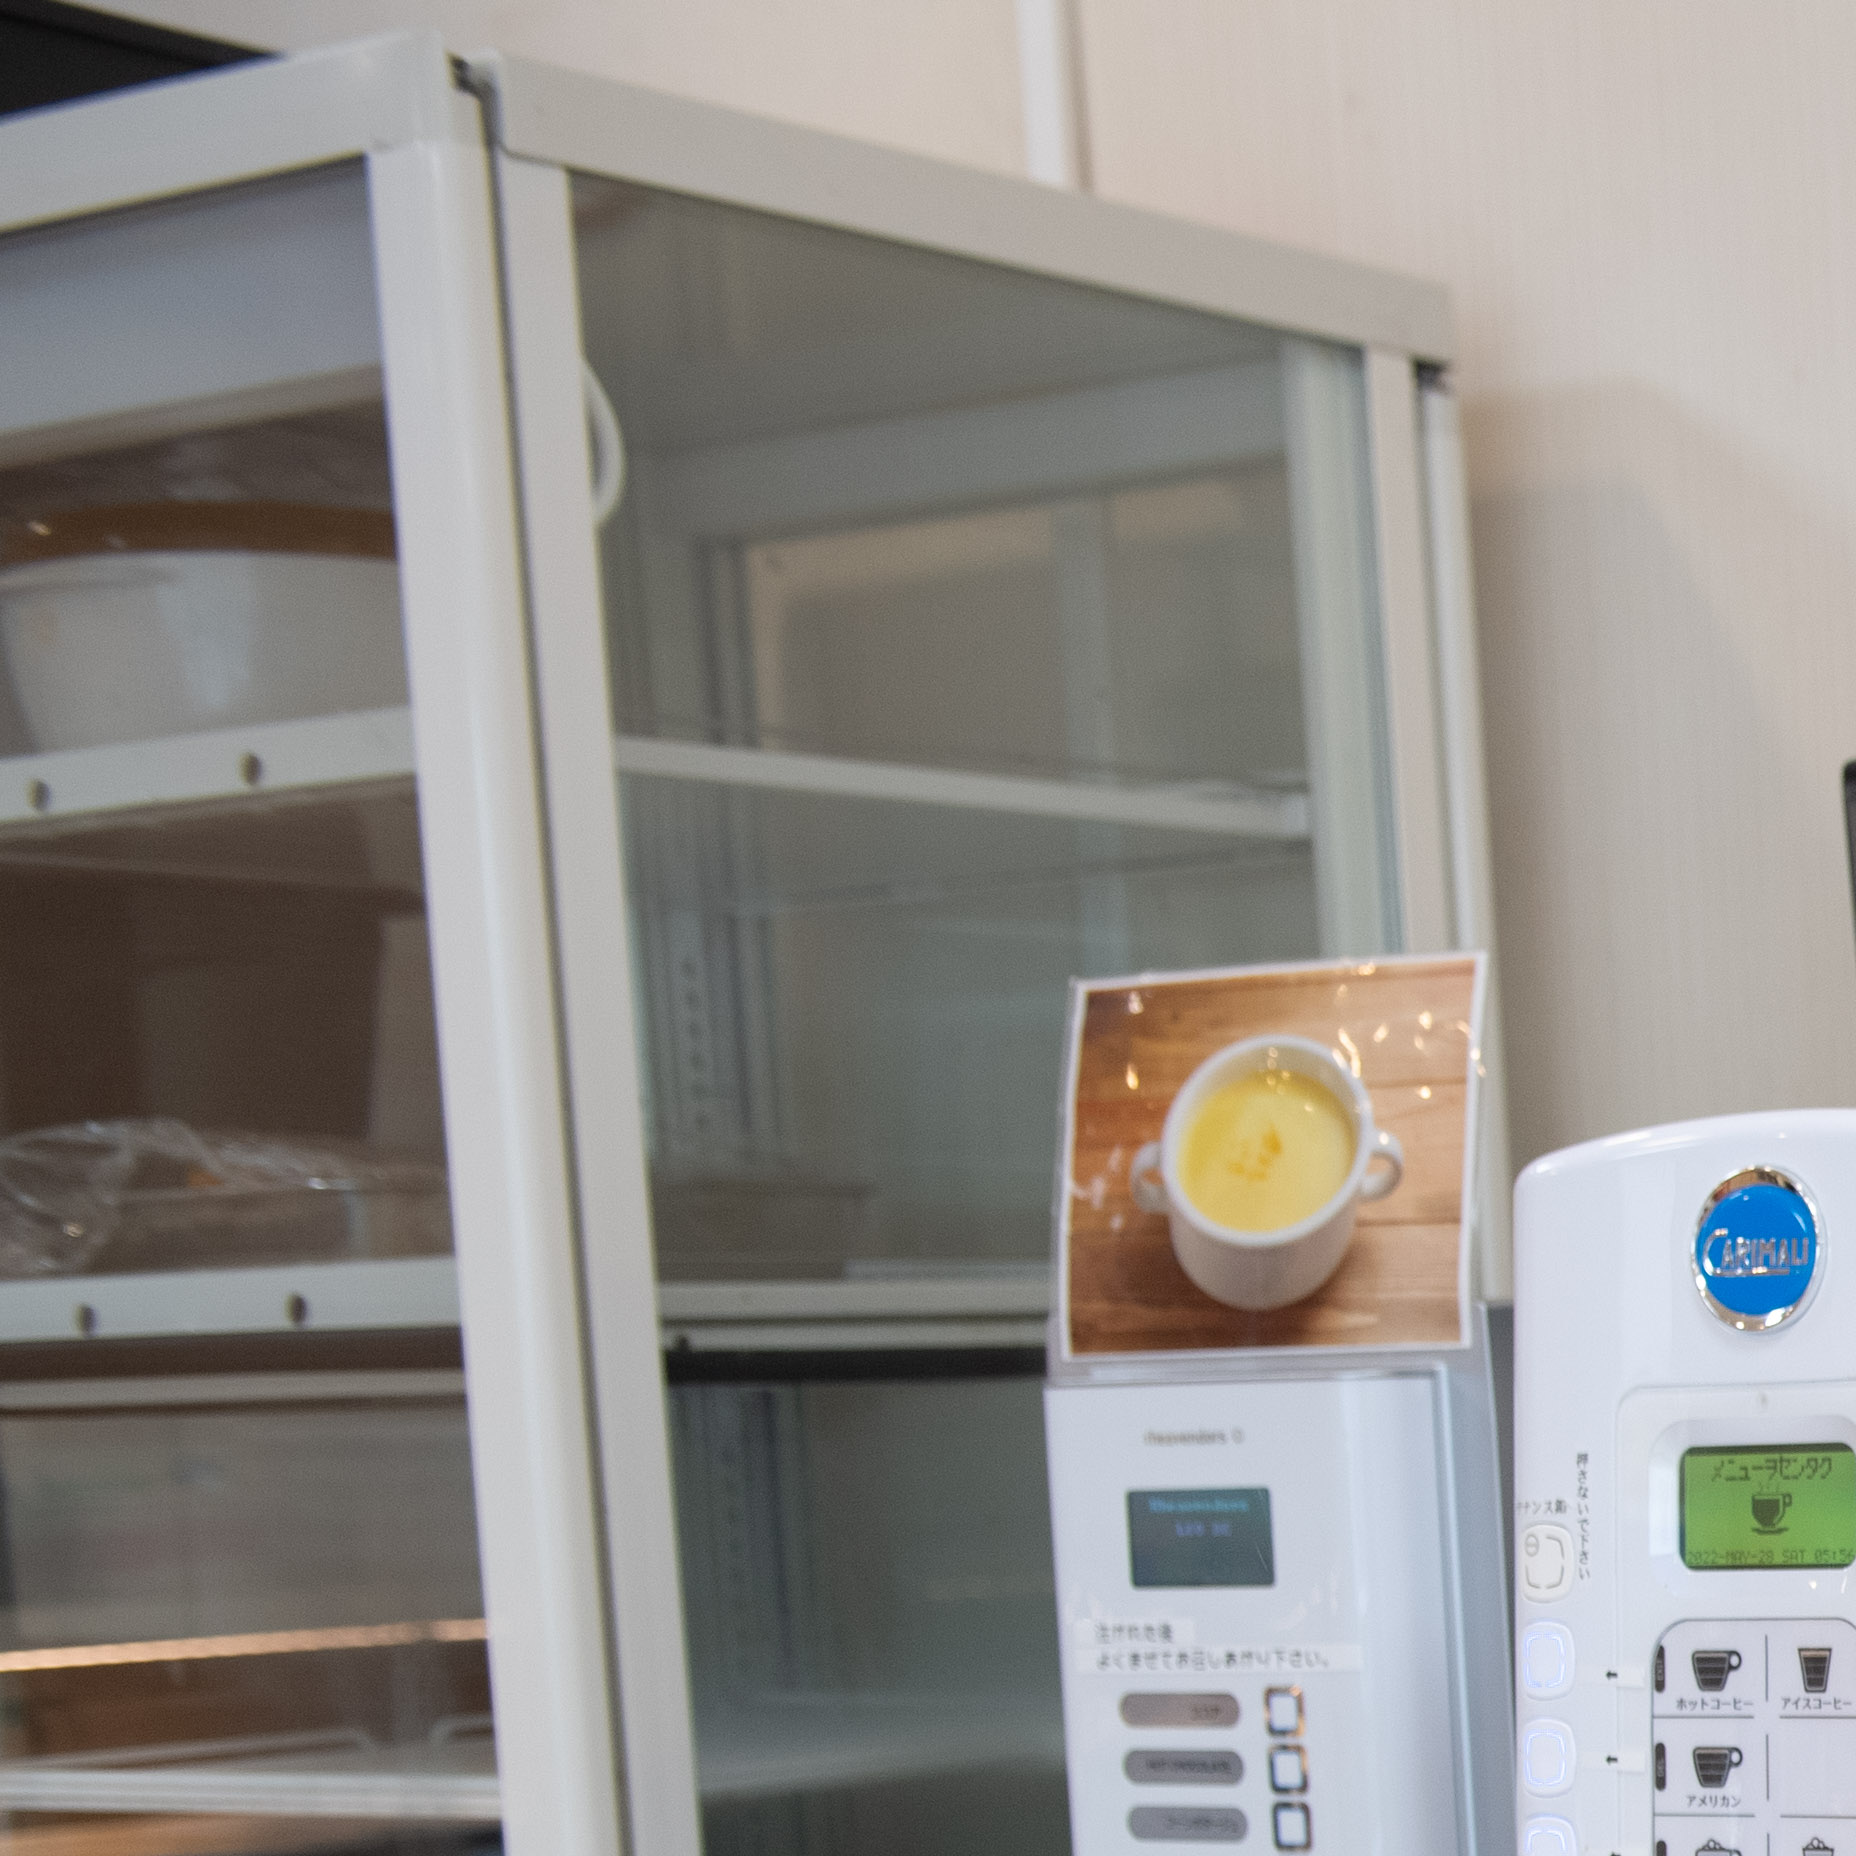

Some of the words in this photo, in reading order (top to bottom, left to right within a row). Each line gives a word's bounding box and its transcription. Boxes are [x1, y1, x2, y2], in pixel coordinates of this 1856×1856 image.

[1703, 1228, 1809, 1276] CARIMALI
[1576, 1453, 1591, 1581] 押さないで下さい
[1675, 1696, 1754, 1712] ホットコーヒー
[1780, 1697, 1852, 1711] アイスコーヒー
[1686, 1795, 1742, 1809] アメリカン
